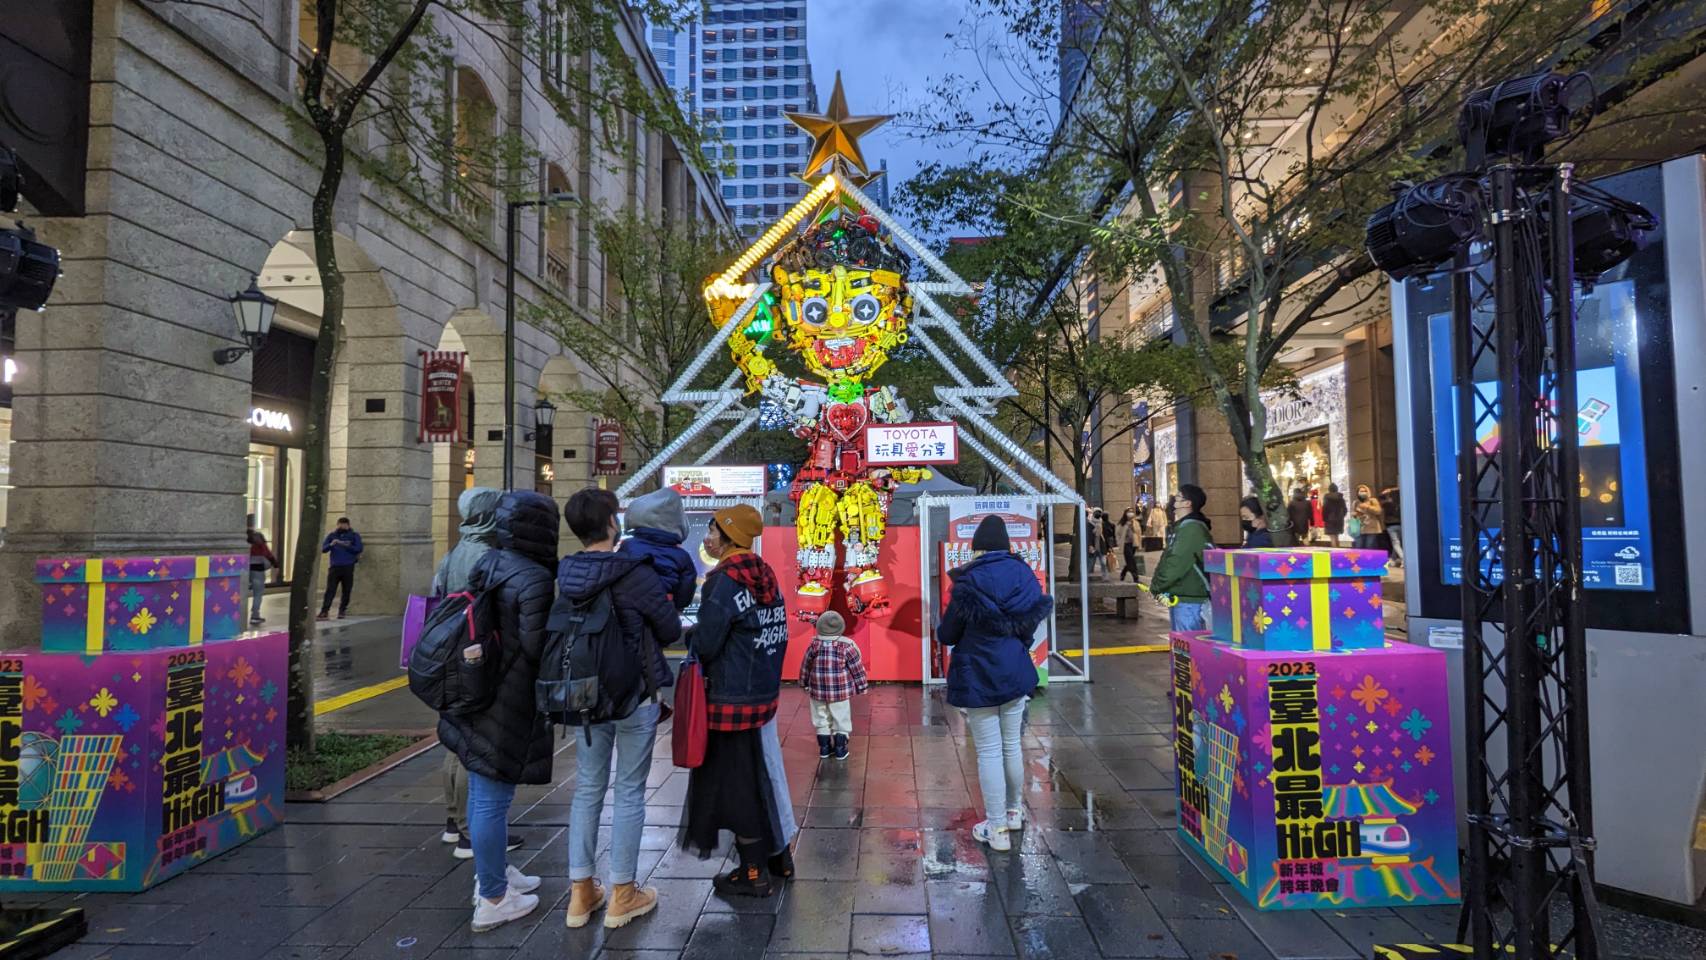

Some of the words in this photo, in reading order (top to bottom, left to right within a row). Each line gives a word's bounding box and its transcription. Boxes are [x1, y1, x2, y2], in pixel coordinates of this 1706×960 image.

[246, 408, 292, 431] OWA
[1274, 402, 1302, 424] DIOR
[883, 429, 938, 440] TOYOTA
[875, 442, 946, 457] 玩具愛分享
[168, 651, 205, 667] 2023
[1268, 662, 1316, 676] 2023
[1269, 680, 1323, 820] 臺北最
